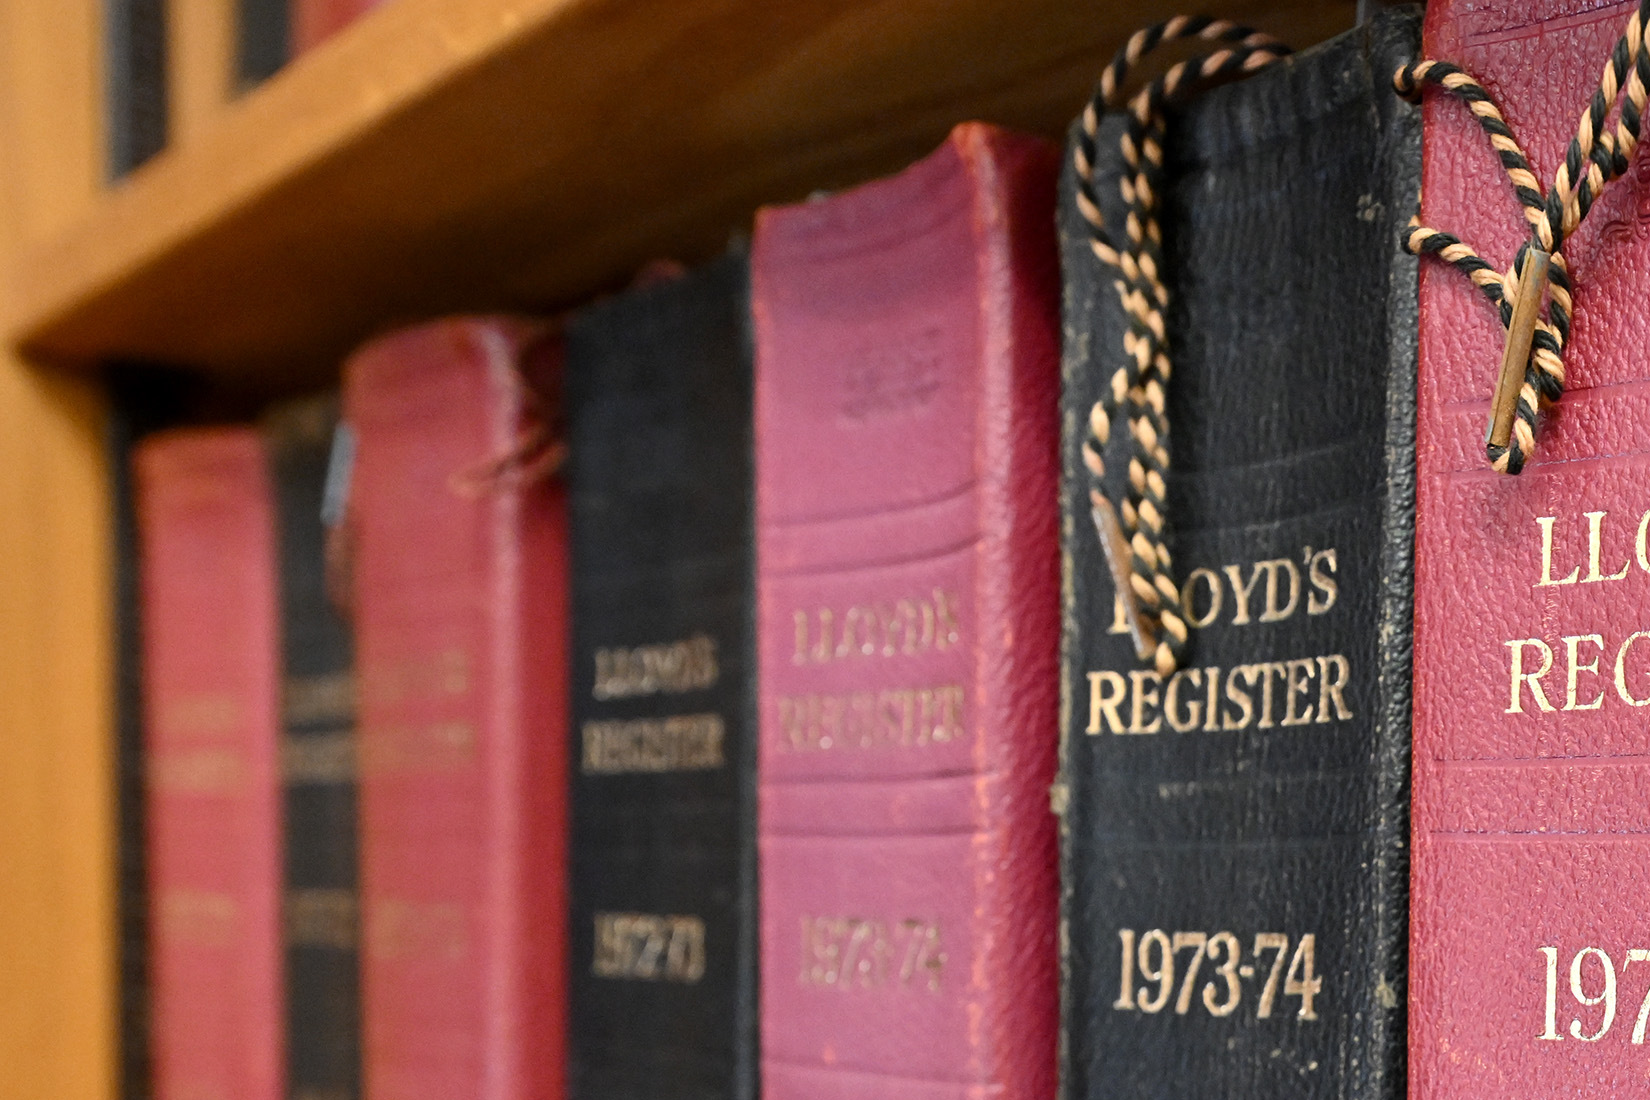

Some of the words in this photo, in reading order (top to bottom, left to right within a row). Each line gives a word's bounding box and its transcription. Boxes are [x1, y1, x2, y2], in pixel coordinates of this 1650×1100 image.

[1106, 546, 1338, 634] OYD'S
[1085, 654, 1353, 735] REGISTER
[1112, 928, 1323, 1021] 1973-74
